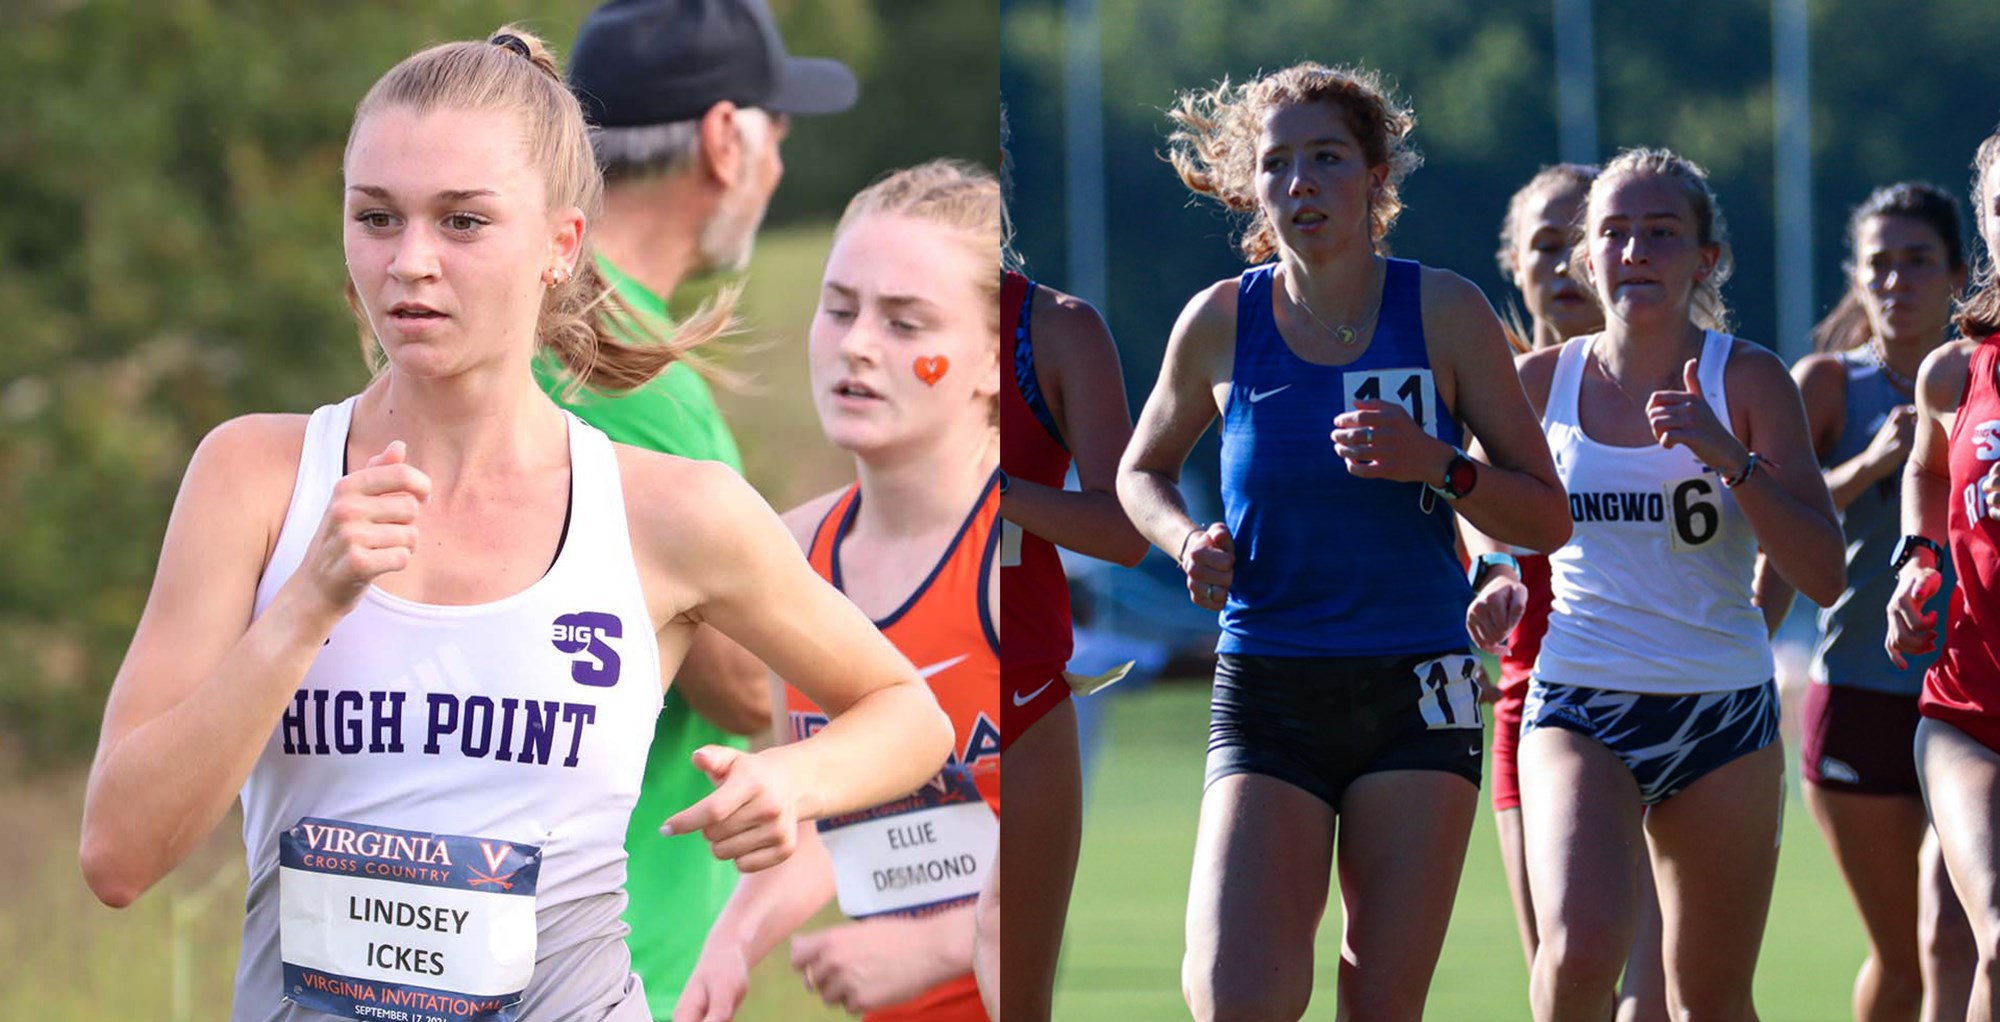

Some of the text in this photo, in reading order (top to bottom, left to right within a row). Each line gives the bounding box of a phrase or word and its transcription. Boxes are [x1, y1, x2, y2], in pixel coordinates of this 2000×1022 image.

[1673, 478, 1719, 546] 6
[551, 611, 623, 688] BIG S
[282, 688, 597, 768] HIGH POINT
[302, 823, 453, 866] VIRGINIA
[886, 822, 938, 850] ELLIE
[302, 853, 451, 883] CROSS COUNTRY
[872, 853, 978, 892] DESMOND
[349, 894, 470, 935] LINDSEY
[366, 942, 445, 976] ICKES
[301, 972, 377, 1001] VIRGINIA
[354, 1004, 409, 1022] SEPTEMBER
